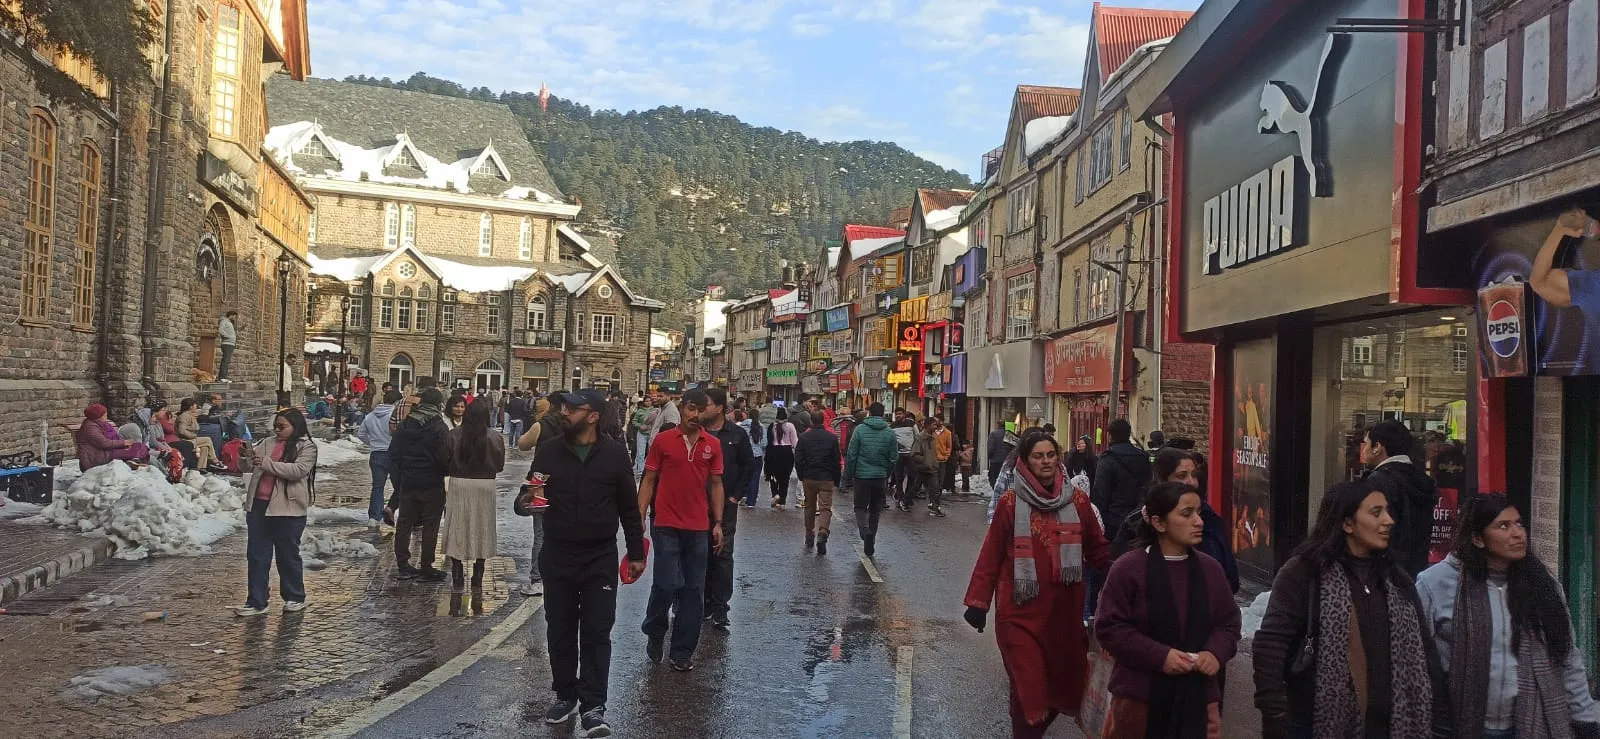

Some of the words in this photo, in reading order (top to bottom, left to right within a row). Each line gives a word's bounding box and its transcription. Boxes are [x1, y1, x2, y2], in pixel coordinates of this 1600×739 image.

[1202, 155, 1295, 275] PUMA
[1236, 449, 1255, 466] SEASON
[1255, 452, 1267, 468] SALE
[1433, 508, 1451, 520] OFF
